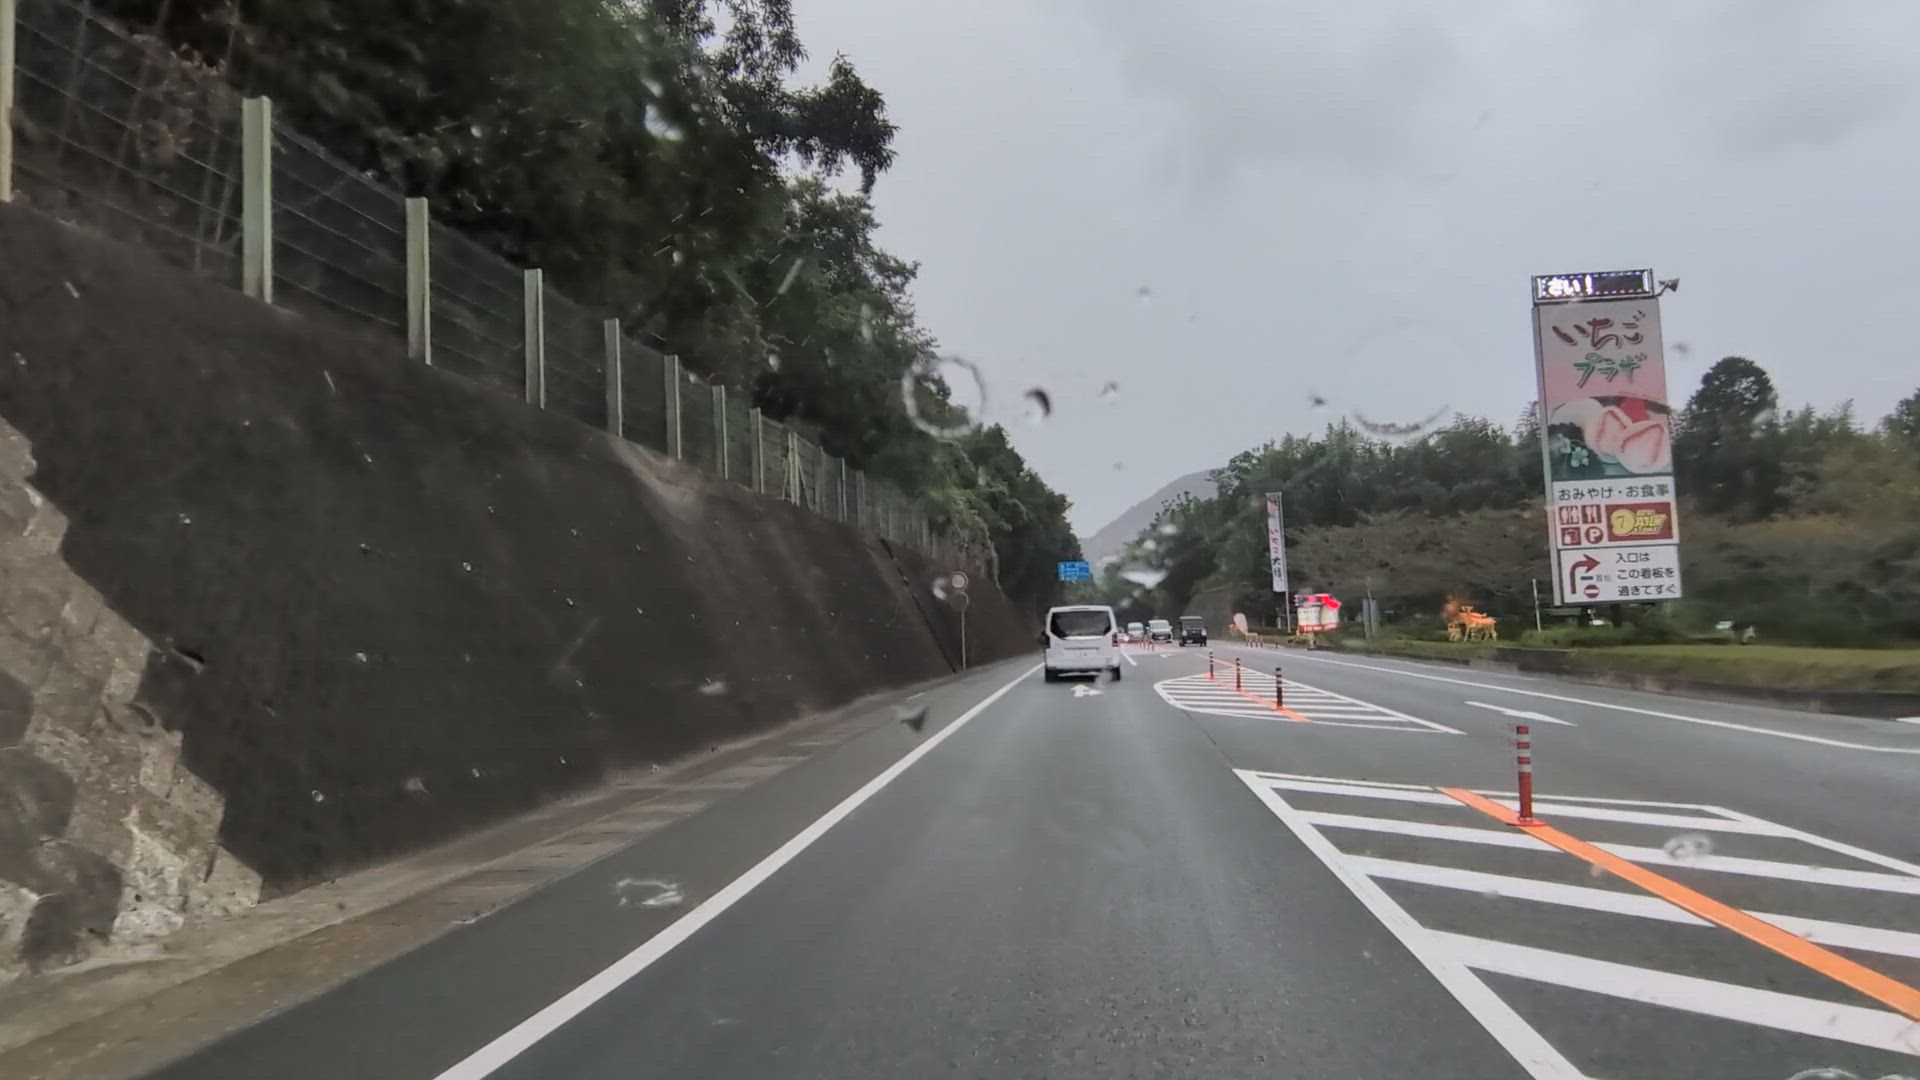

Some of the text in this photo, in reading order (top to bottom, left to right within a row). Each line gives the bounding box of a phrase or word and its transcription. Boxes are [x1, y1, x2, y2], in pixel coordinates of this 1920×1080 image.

[1552, 310, 1646, 350] いちご
[1573, 352, 1648, 388] プラザ
[1558, 484, 1670, 501] おみやげ・お食事
[1616, 552, 1650, 564] 入口は
[1617, 567, 1675, 580] この看板を
[1618, 584, 1677, 597] 過ぎてすぐ
